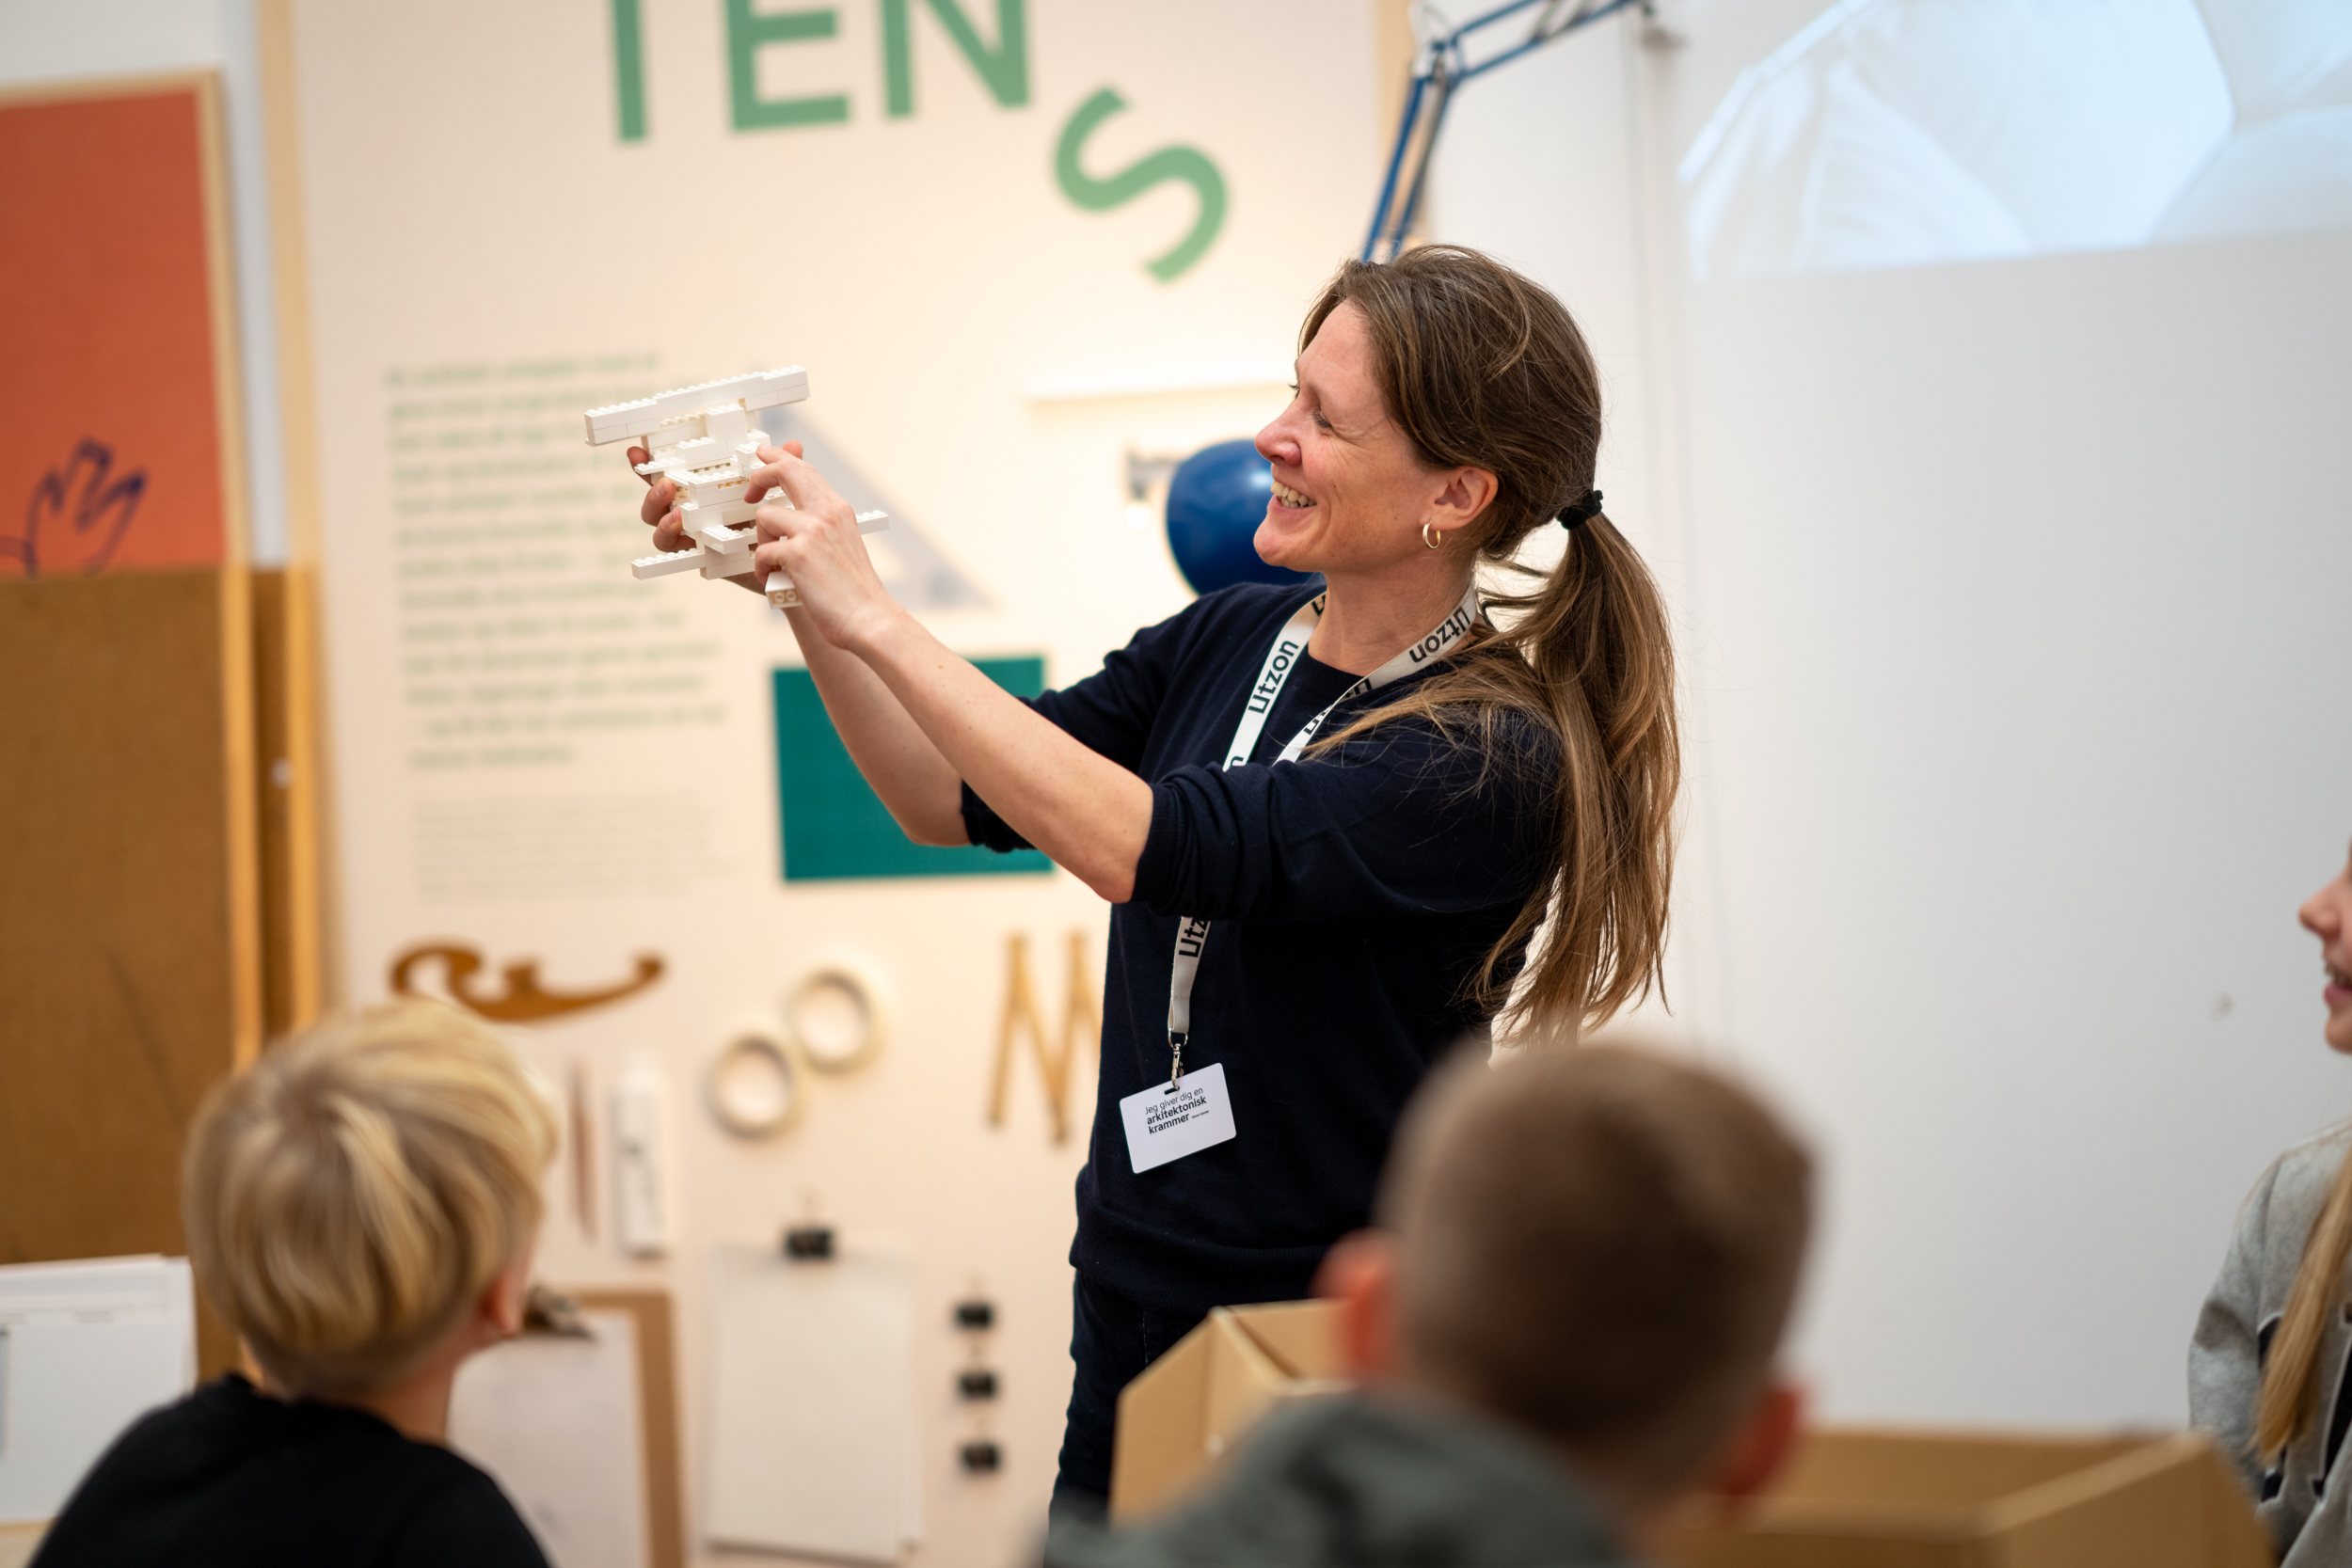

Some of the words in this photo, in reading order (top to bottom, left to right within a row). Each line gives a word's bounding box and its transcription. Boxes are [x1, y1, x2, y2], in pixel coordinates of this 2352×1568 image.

[1409, 606, 1471, 663] Utzon
[1248, 640, 1299, 715] Utzon
[1178, 918, 1208, 958] Utz
[1145, 1104, 1158, 1115] Jeg
[1159, 1097, 1178, 1110] giver
[1180, 1091, 1193, 1101] dig
[1194, 1087, 1203, 1096] en
[1147, 1096, 1207, 1125] arkitektonisk
[1148, 1113, 1190, 1134] krammer
